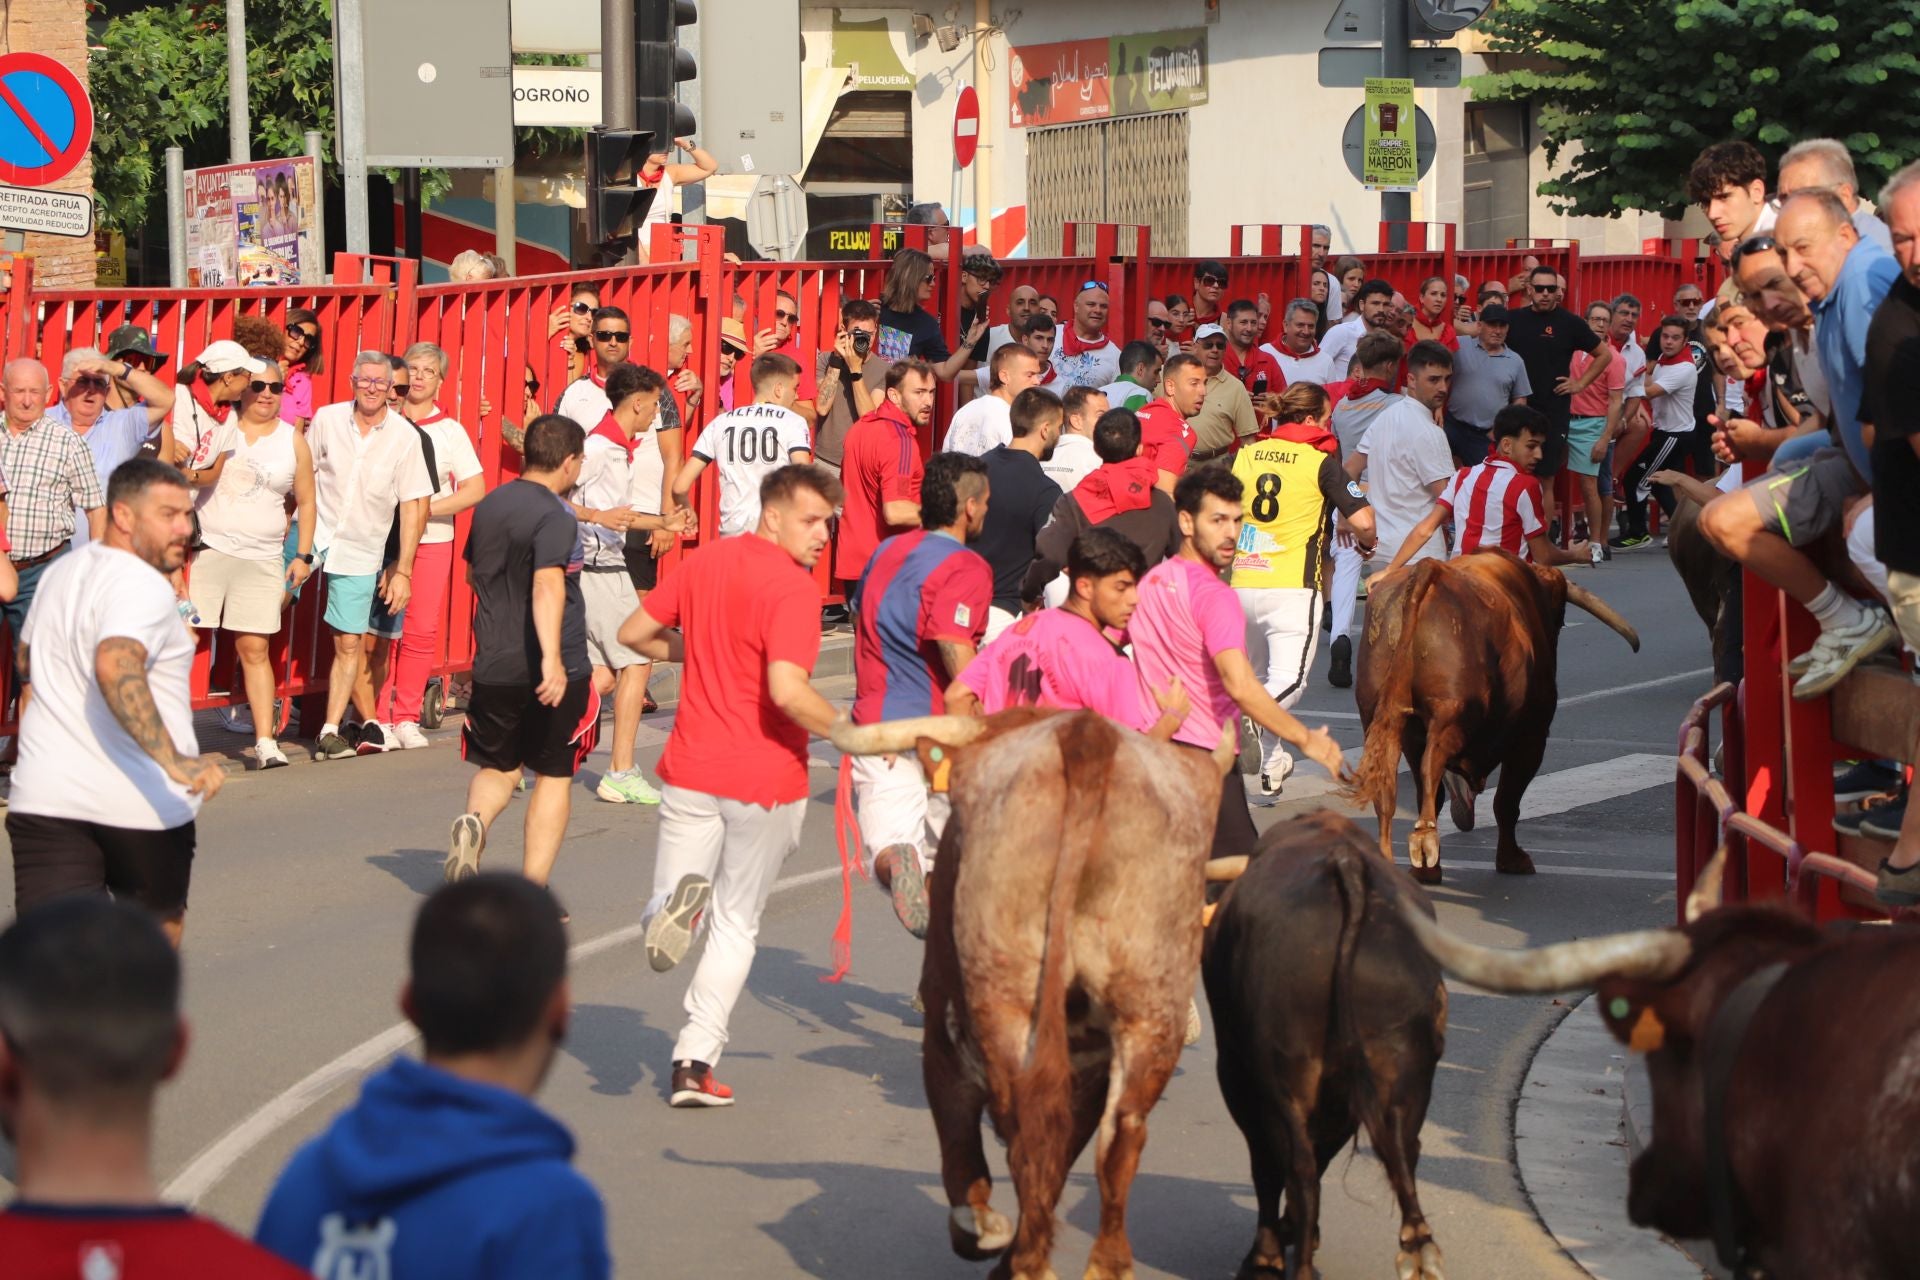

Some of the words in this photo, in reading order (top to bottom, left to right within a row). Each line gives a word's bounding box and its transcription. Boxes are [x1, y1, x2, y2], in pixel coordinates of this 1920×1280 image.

[858, 74, 910, 86] PELUQUERÍA
[514, 85, 590, 103] OGROÑO
[1369, 146, 1411, 156] CONTENEDOR
[30, 208, 83, 221] ACREDITADOS
[2, 214, 44, 226] MOVILIDAD
[45, 219, 85, 231] REDUCIDA
[722, 426, 778, 465] 100
[1254, 450, 1299, 464] ELISSALT
[1251, 472, 1282, 523] 8
